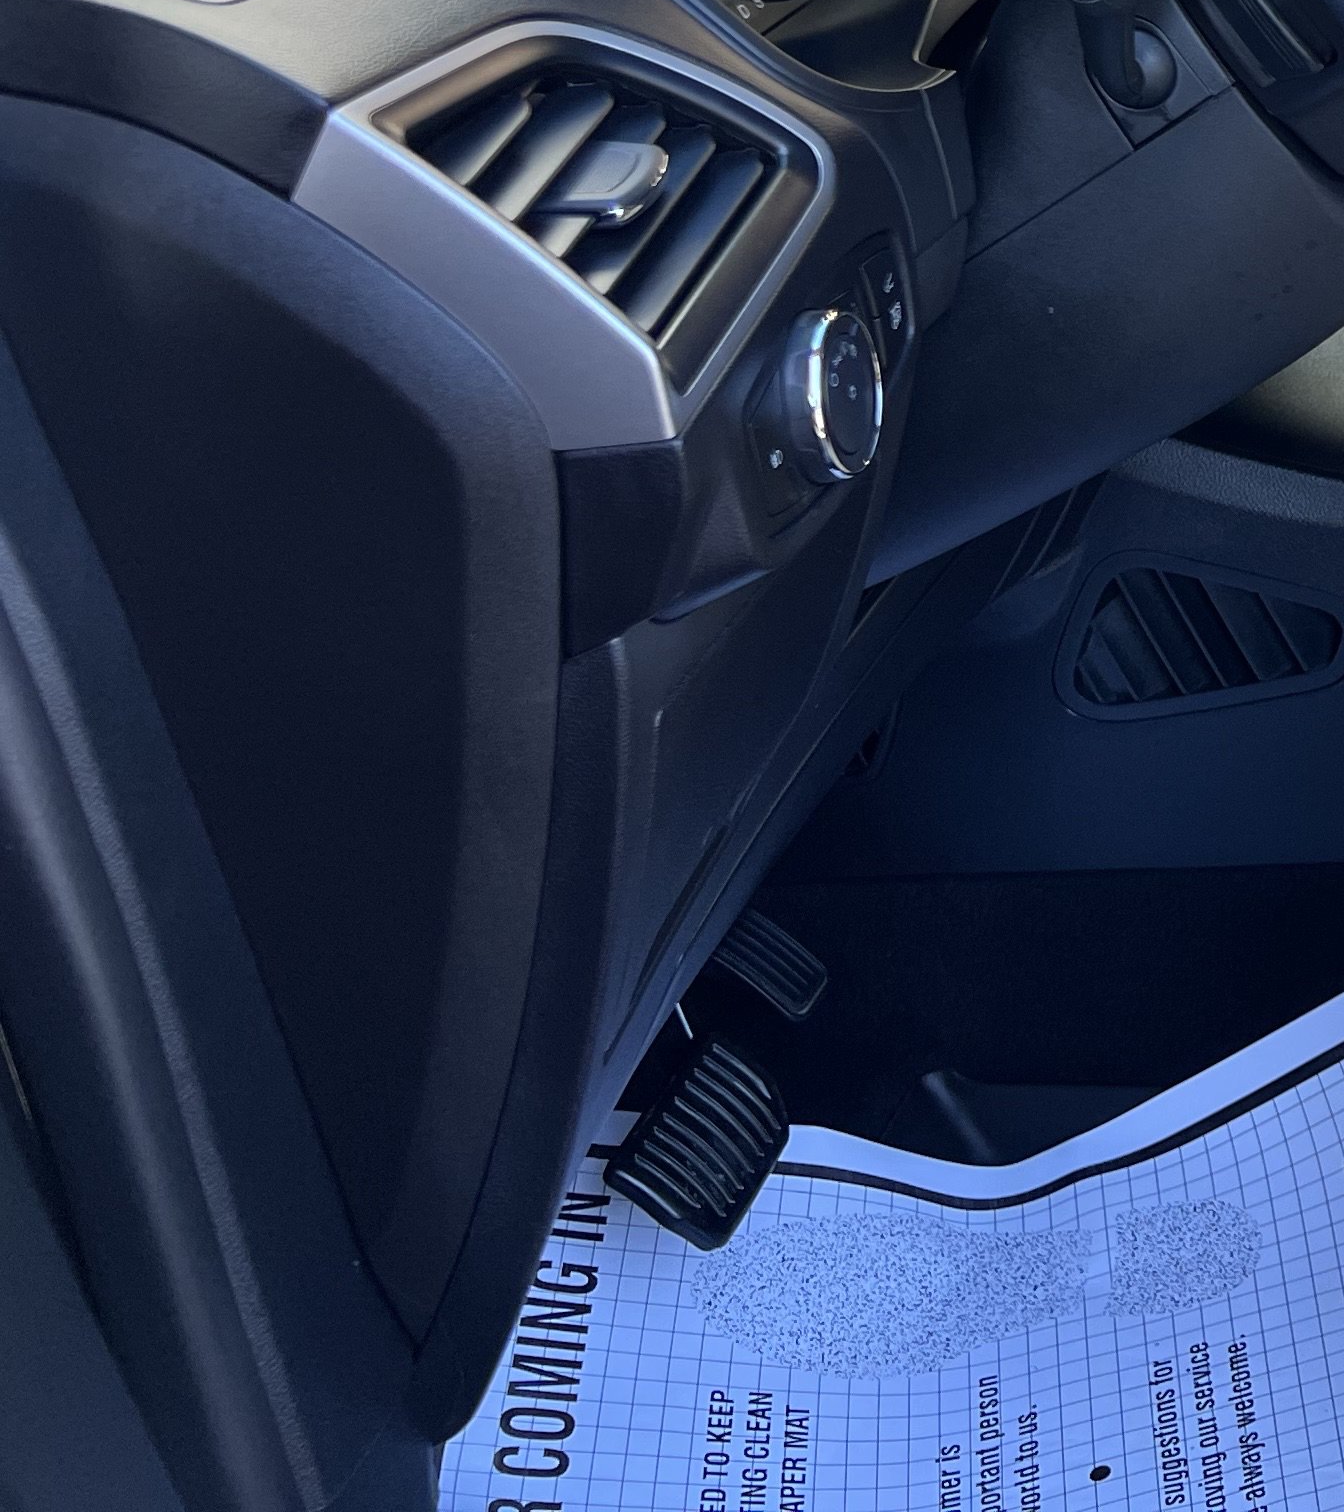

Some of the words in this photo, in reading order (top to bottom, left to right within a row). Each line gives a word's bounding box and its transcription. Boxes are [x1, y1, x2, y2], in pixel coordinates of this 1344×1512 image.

[494, 1259, 600, 1478] COMING
[551, 1191, 612, 1242] IN
[1148, 1358, 1173, 1387] for
[1185, 1340, 1214, 1413] service
[1228, 1334, 1259, 1431] welcome.
[706, 1389, 735, 1443] KEEP
[743, 1391, 774, 1459] CLEAN
[783, 1404, 811, 1449] MAT
[978, 1374, 1006, 1442] person
[1018, 1403, 1039, 1436] us.
[935, 1443, 961, 1463] is
[1014, 1440, 1039, 1462] to
[1152, 1386, 1189, 1506] suggestions
[1196, 1417, 1220, 1449] our
[702, 1452, 730, 1480] TO
[739, 1468, 767, 1512] ING
[941, 1469, 961, 1512] mer
[1197, 1451, 1228, 1512] oving
[1239, 1431, 1266, 1501] always
